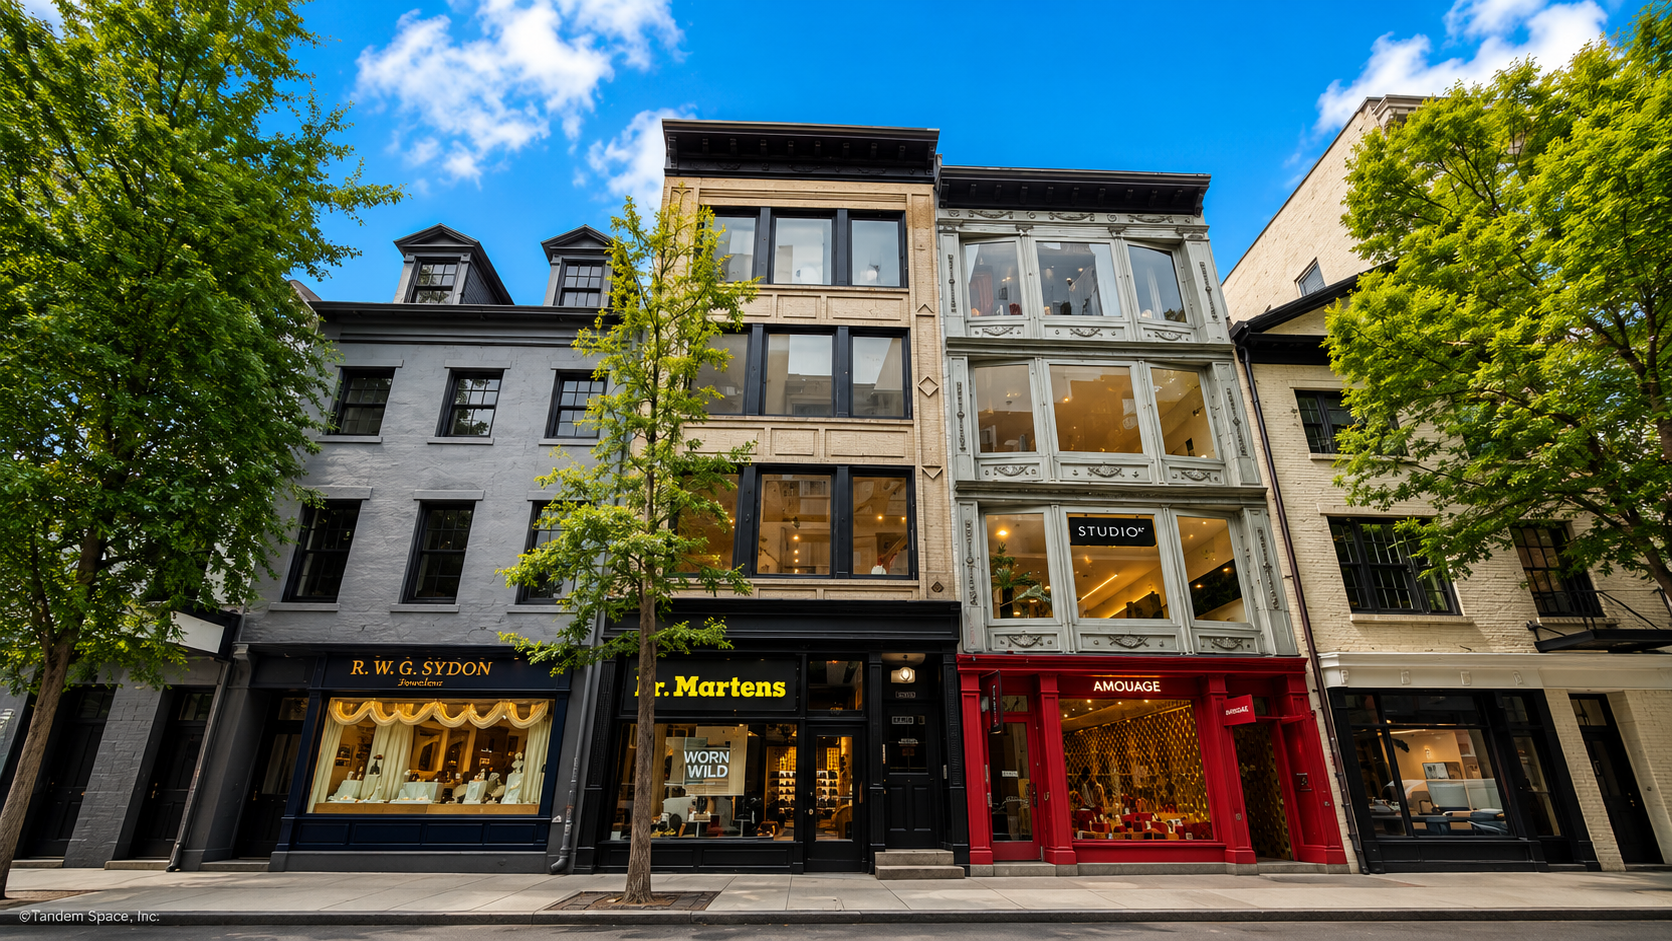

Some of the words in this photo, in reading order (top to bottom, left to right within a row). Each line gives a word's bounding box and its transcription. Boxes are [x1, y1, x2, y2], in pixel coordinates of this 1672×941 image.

[350, 660, 369, 675] R.
[373, 660, 395, 675] W.
[398, 661, 418, 676] G.
[421, 661, 493, 676] SYDON
[634, 675, 670, 697] r.
[673, 675, 786, 698] Martens
[1093, 681, 1161, 692] AMOUAGE
[684, 751, 730, 764] WORN
[687, 764, 728, 778] WILD
